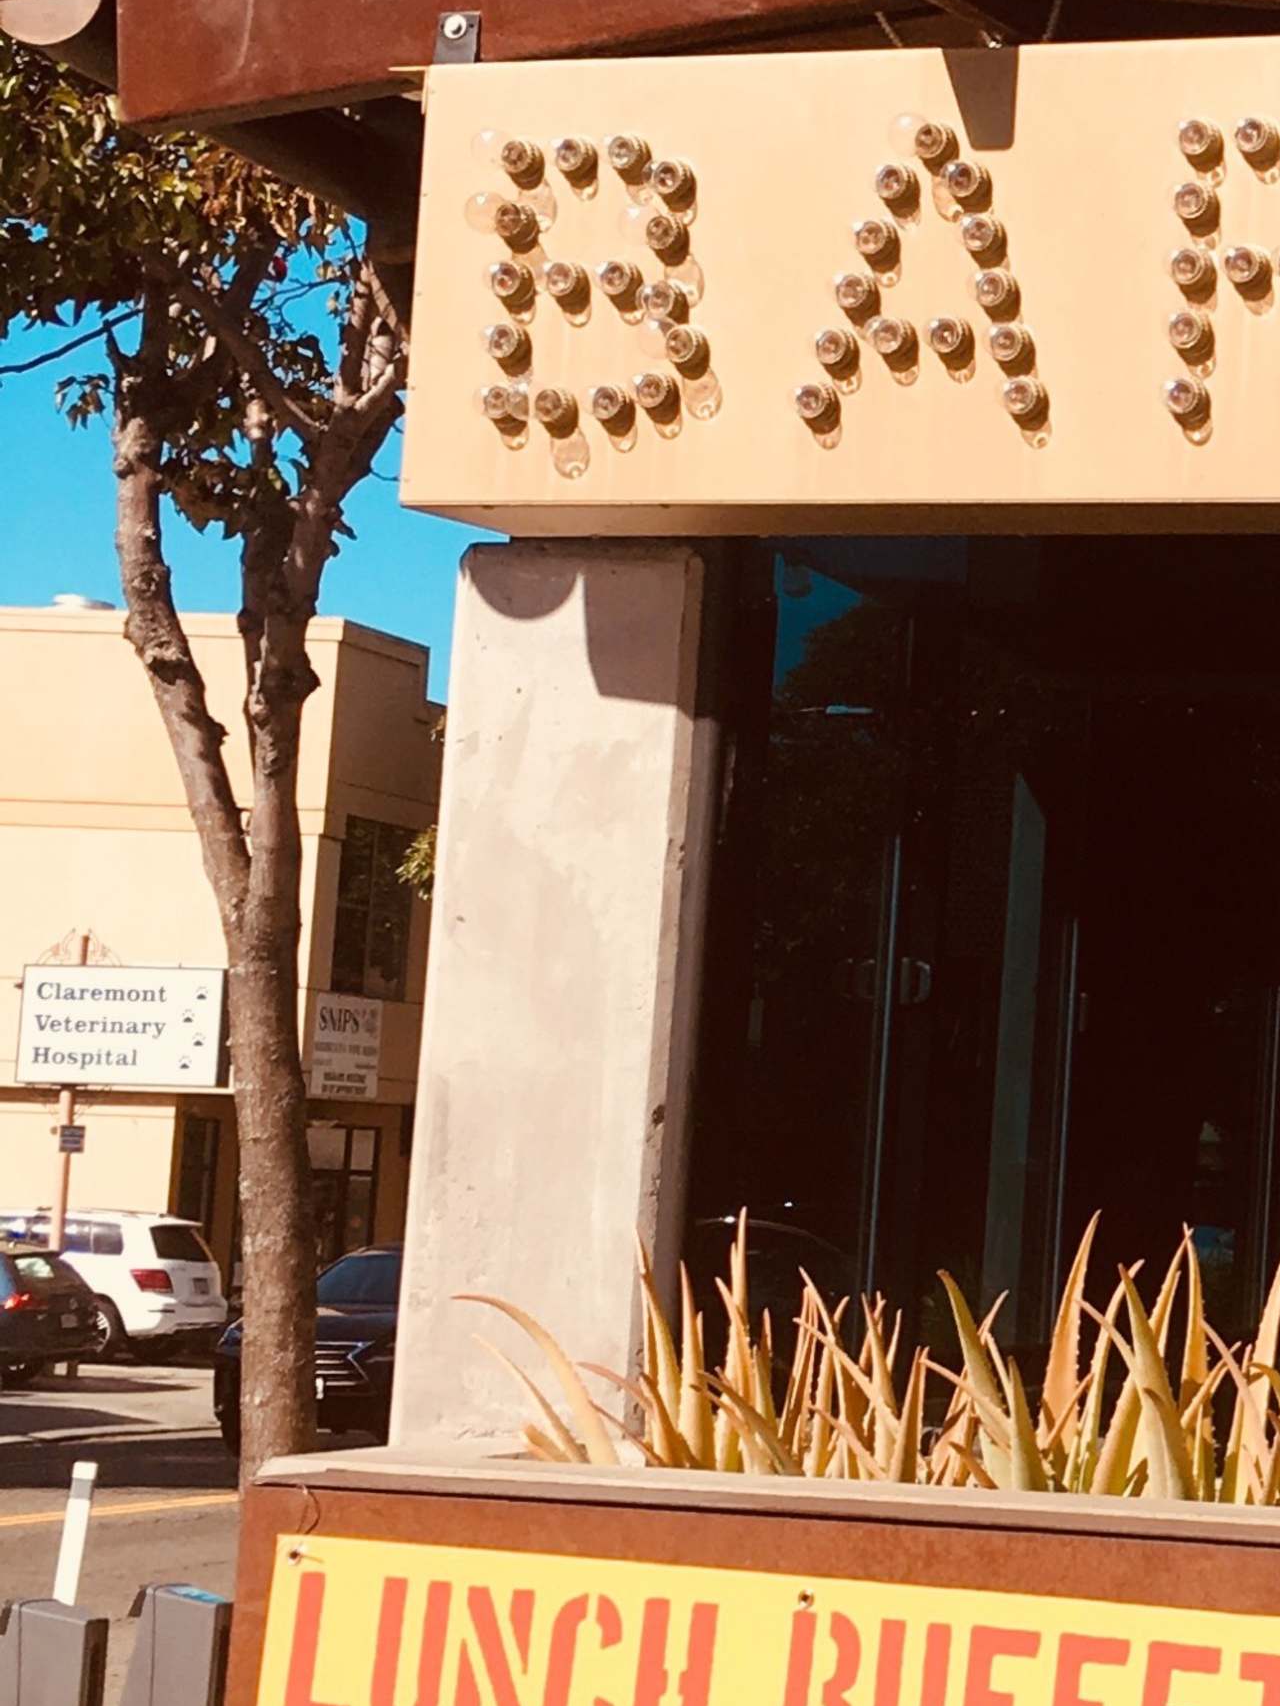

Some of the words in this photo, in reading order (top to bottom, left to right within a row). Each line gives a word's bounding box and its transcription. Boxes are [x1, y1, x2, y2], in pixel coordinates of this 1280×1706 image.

[37, 981, 168, 1003] Claremont
[35, 1013, 167, 1039] Veterinary
[319, 1006, 360, 1034] SNIPS
[31, 1046, 138, 1070] Hospital
